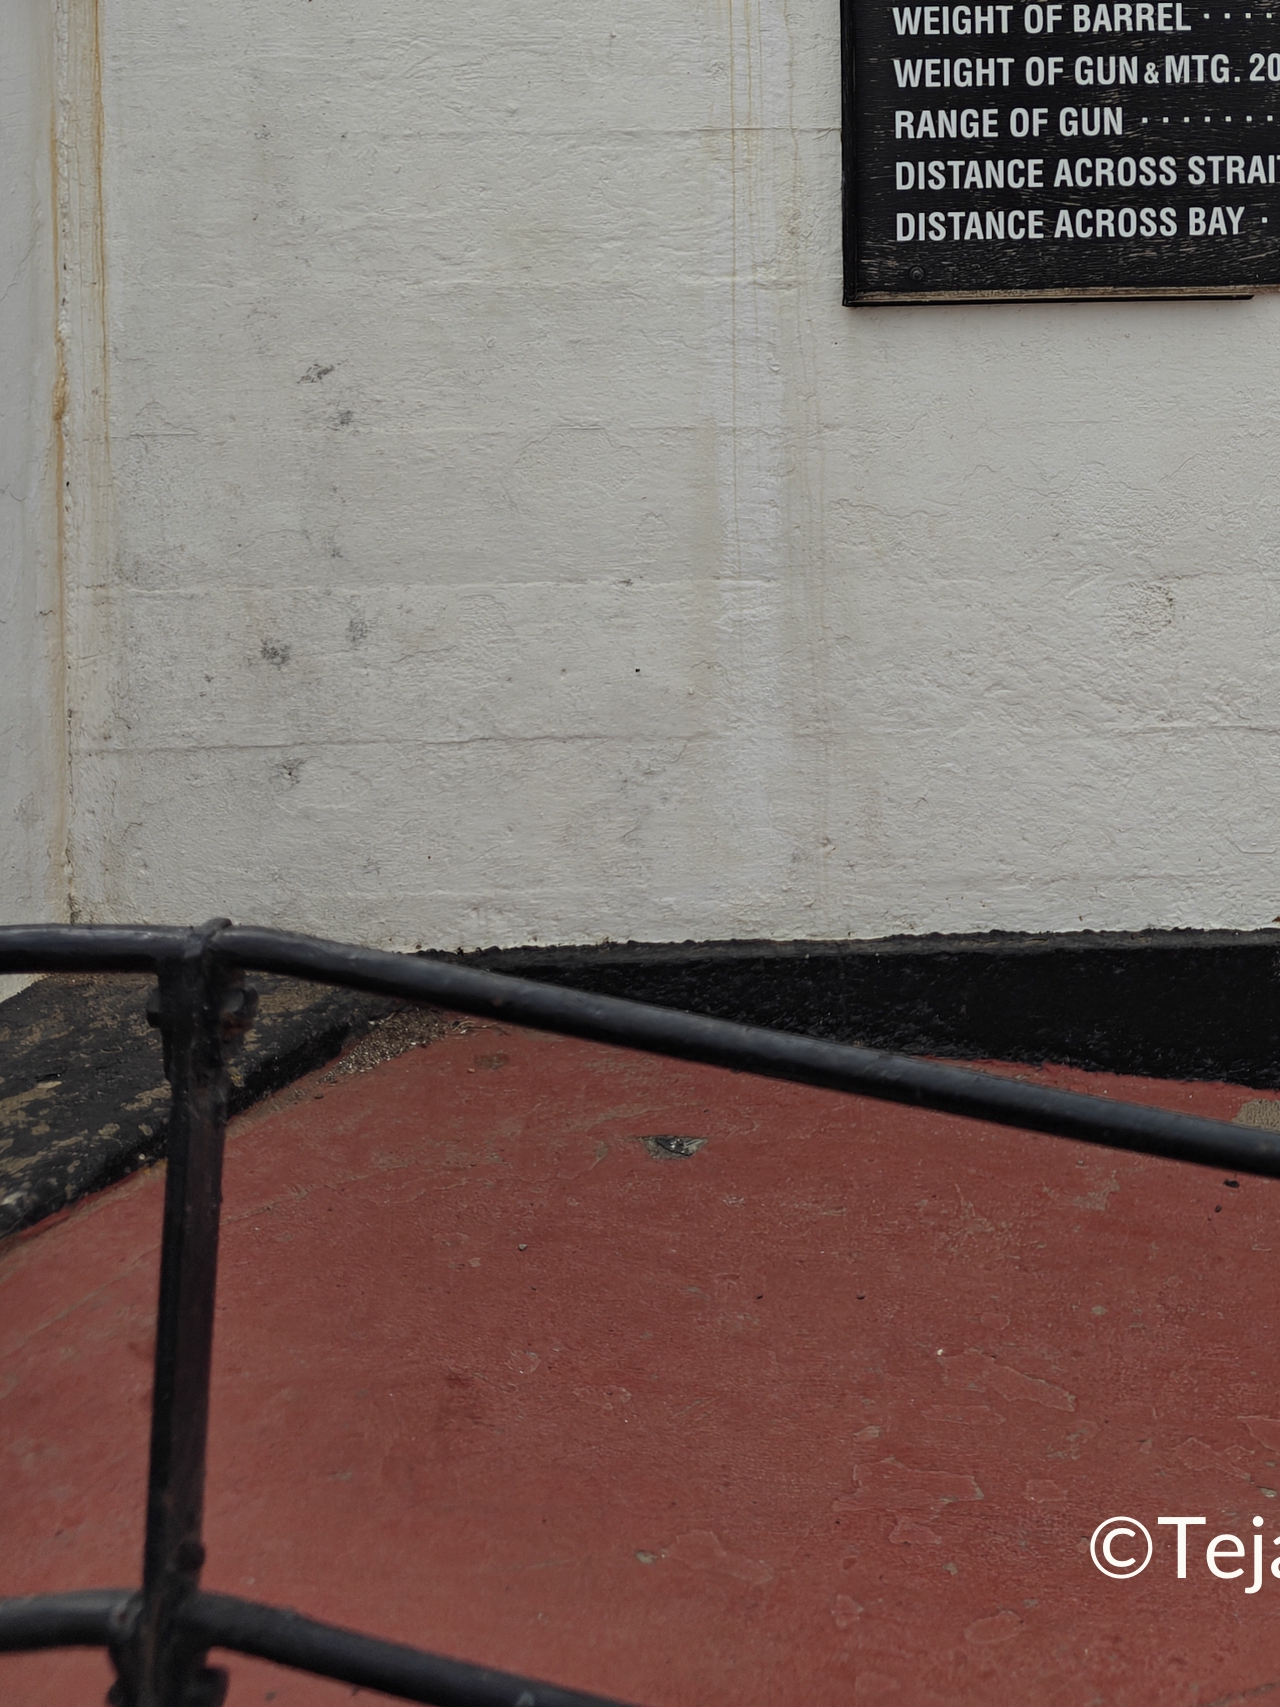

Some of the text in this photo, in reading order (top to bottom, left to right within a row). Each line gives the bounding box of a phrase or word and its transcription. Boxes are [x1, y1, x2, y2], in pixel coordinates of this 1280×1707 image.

[892, 5, 1014, 35] WEIGHT
[1024, 4, 1063, 34] OF
[1073, 2, 1192, 33] BARREL
[893, 57, 1015, 88] WEIGHT
[1025, 56, 1064, 87] OF
[895, 108, 999, 139] RANGE
[1010, 107, 1049, 138] OF
[1059, 106, 1123, 137] GUN
[895, 159, 1044, 190] DISTANCE
[1053, 156, 1177, 187] ACROSS
[896, 210, 1044, 242] DISTANCE
[1053, 207, 1177, 238] ACROSS
[1189, 206, 1245, 236] BAY
